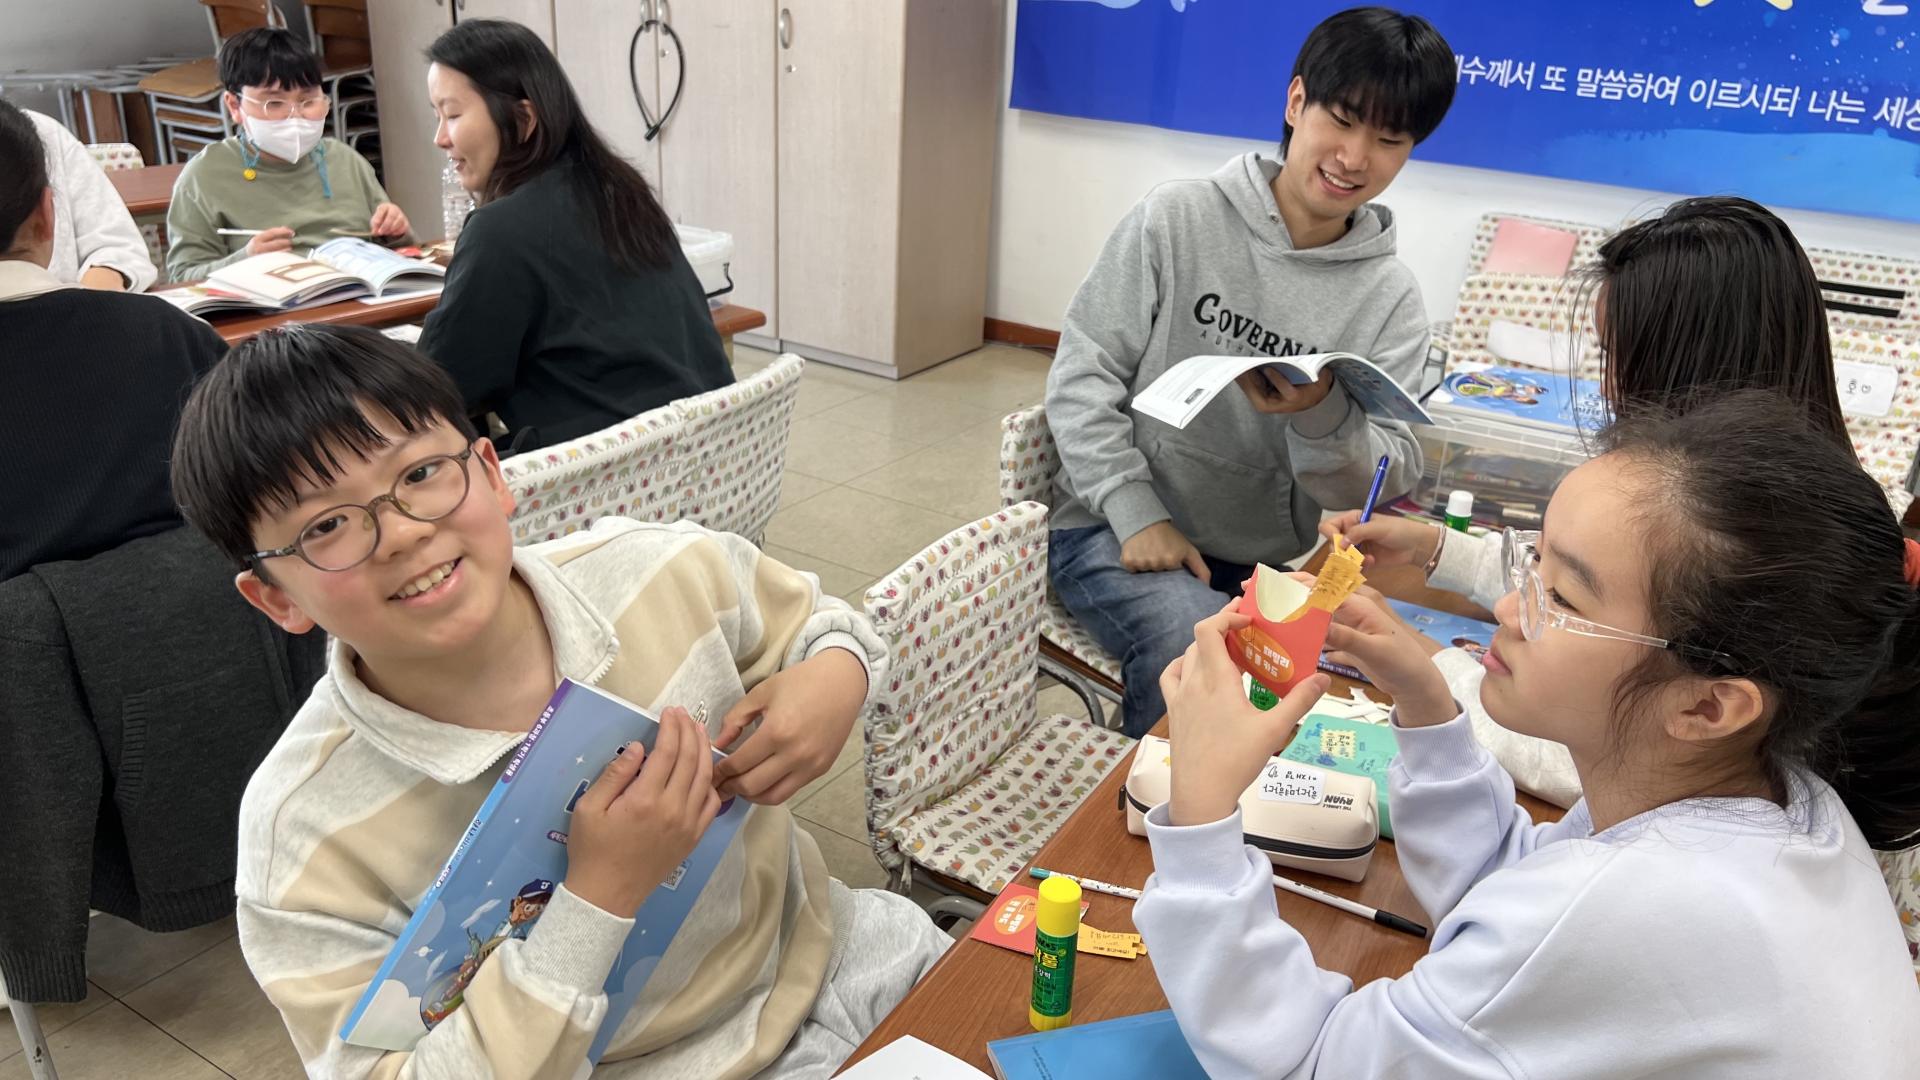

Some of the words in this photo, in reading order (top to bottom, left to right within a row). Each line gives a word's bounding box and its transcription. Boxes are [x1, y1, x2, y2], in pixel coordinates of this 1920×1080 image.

[1540, 65, 1567, 92] 또
[1576, 66, 1681, 106] 말씀하여
[1689, 78, 1800, 118] 이르시되
[1808, 90, 1866, 124] 나는
[1323, 795, 1354, 806] RYAN
